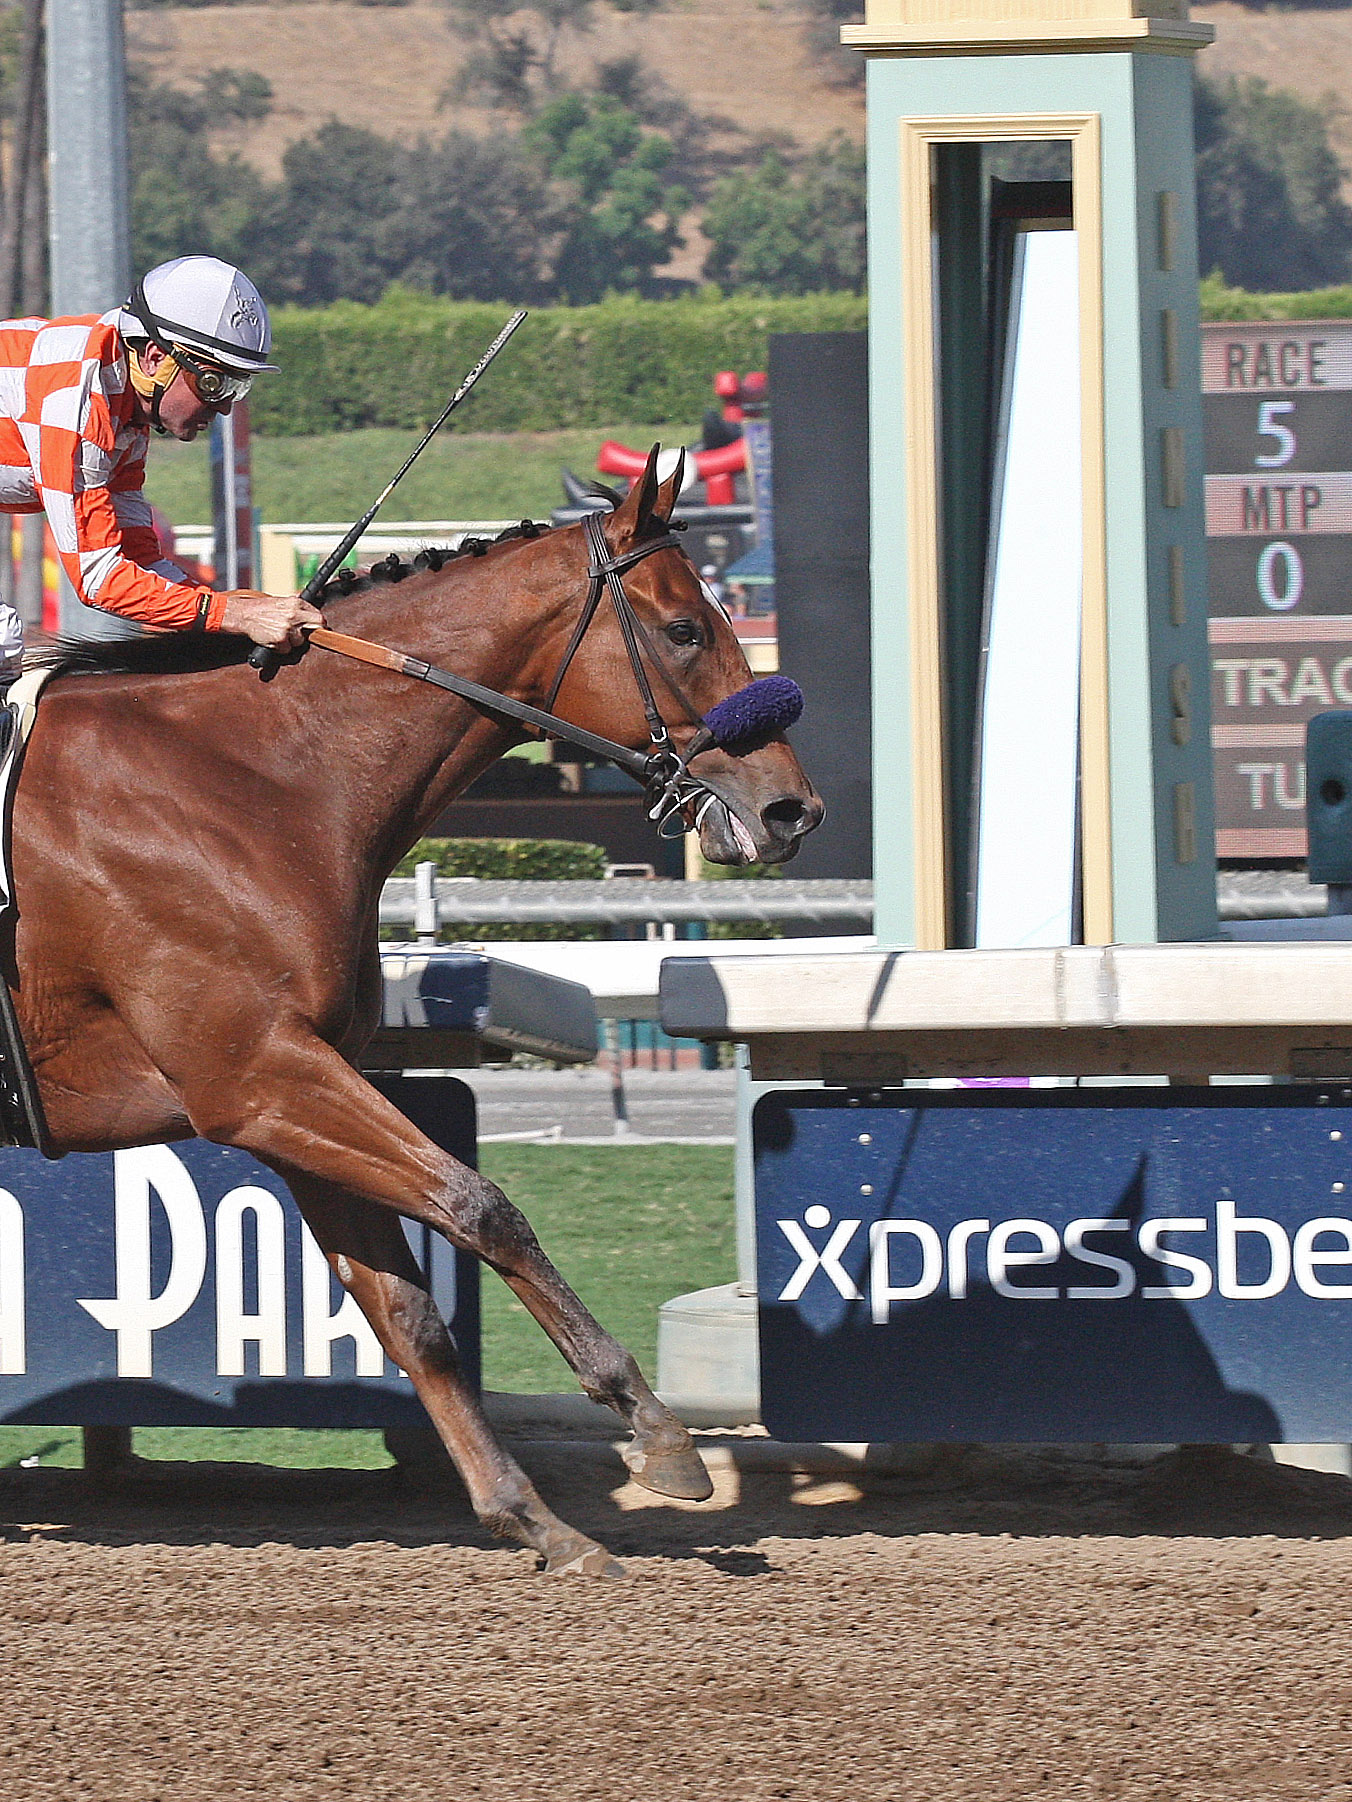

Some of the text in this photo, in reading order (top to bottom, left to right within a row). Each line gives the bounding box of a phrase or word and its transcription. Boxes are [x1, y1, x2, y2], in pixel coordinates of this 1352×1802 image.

[1224, 340, 1326, 387] RACE
[1254, 401, 1297, 467] 5
[1242, 485, 1322, 530] MTP
[1256, 541, 1305, 611] 0
